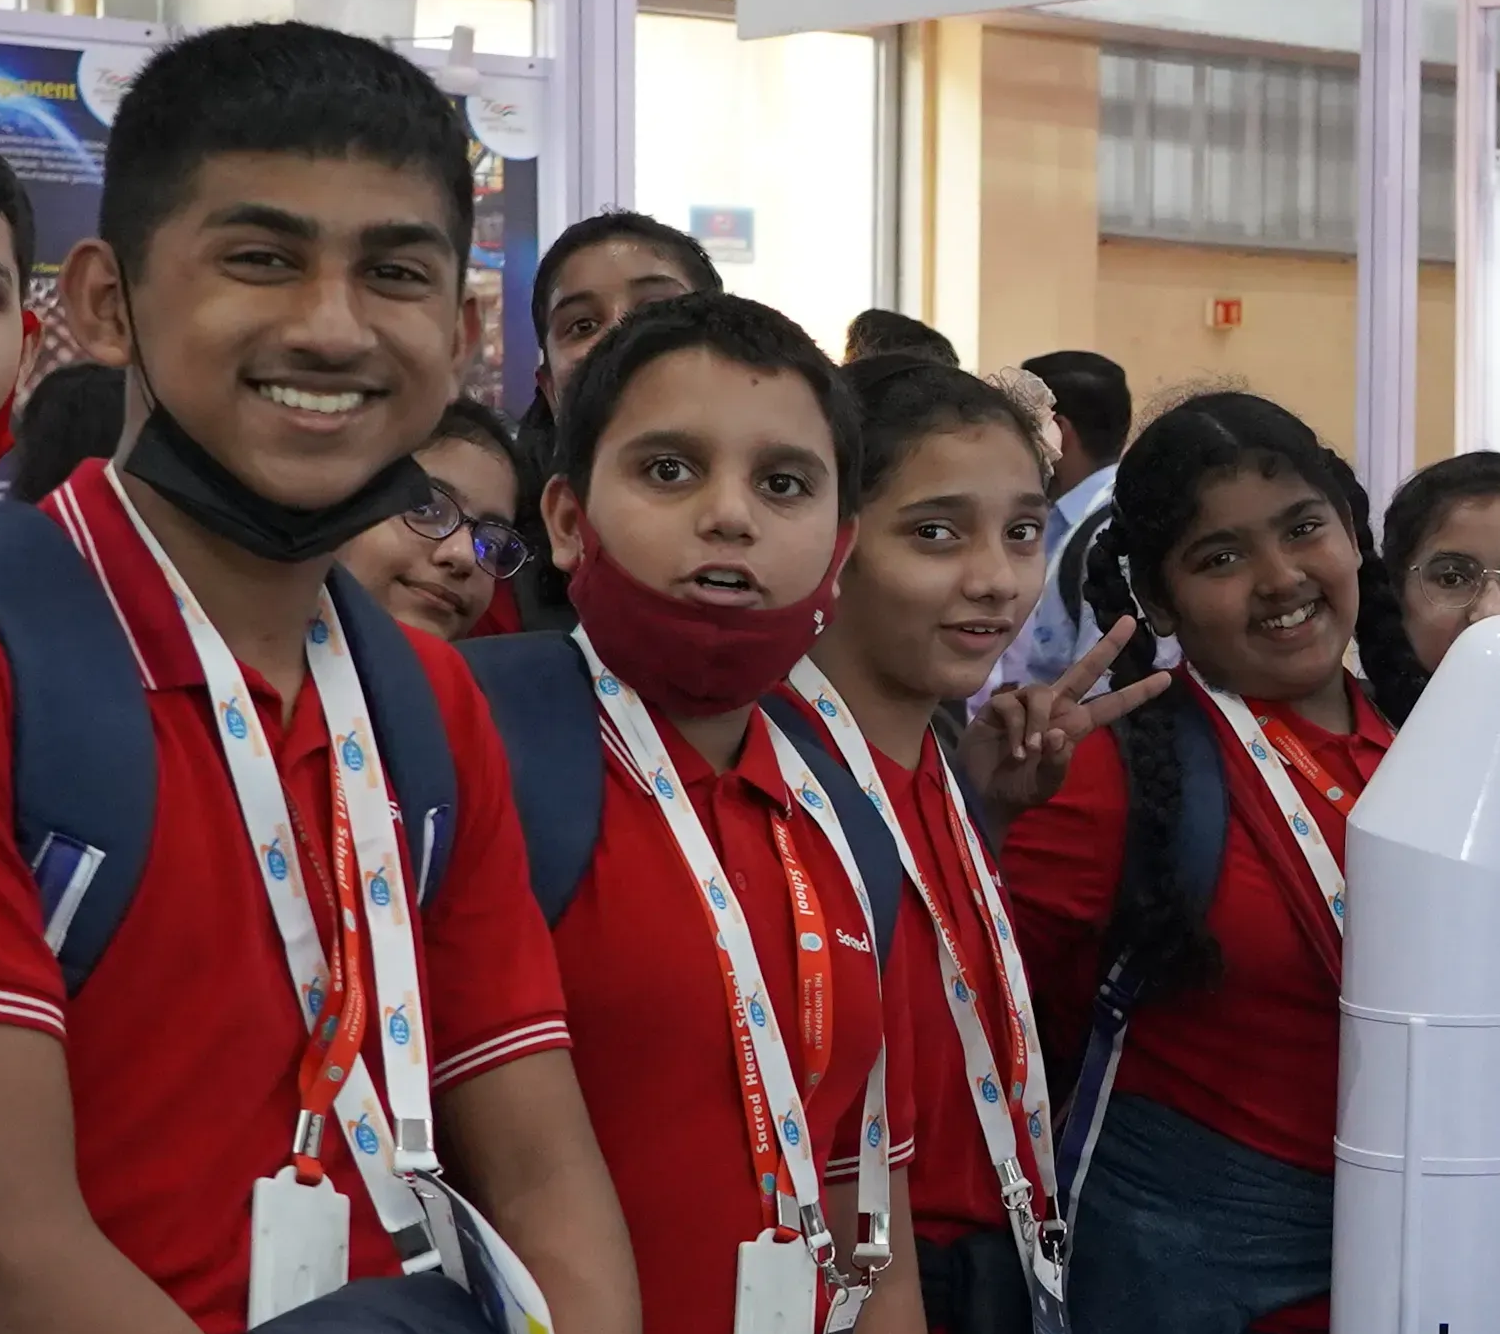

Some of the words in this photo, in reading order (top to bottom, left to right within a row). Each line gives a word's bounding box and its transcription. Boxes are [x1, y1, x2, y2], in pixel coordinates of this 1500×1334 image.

[337, 823, 351, 892] School
[775, 822, 796, 865] Heart
[789, 866, 816, 917] School
[813, 989, 825, 1051] UNSTOPPABLE
[740, 1034, 758, 1087] Heart
[748, 1093, 770, 1155] Sacred
